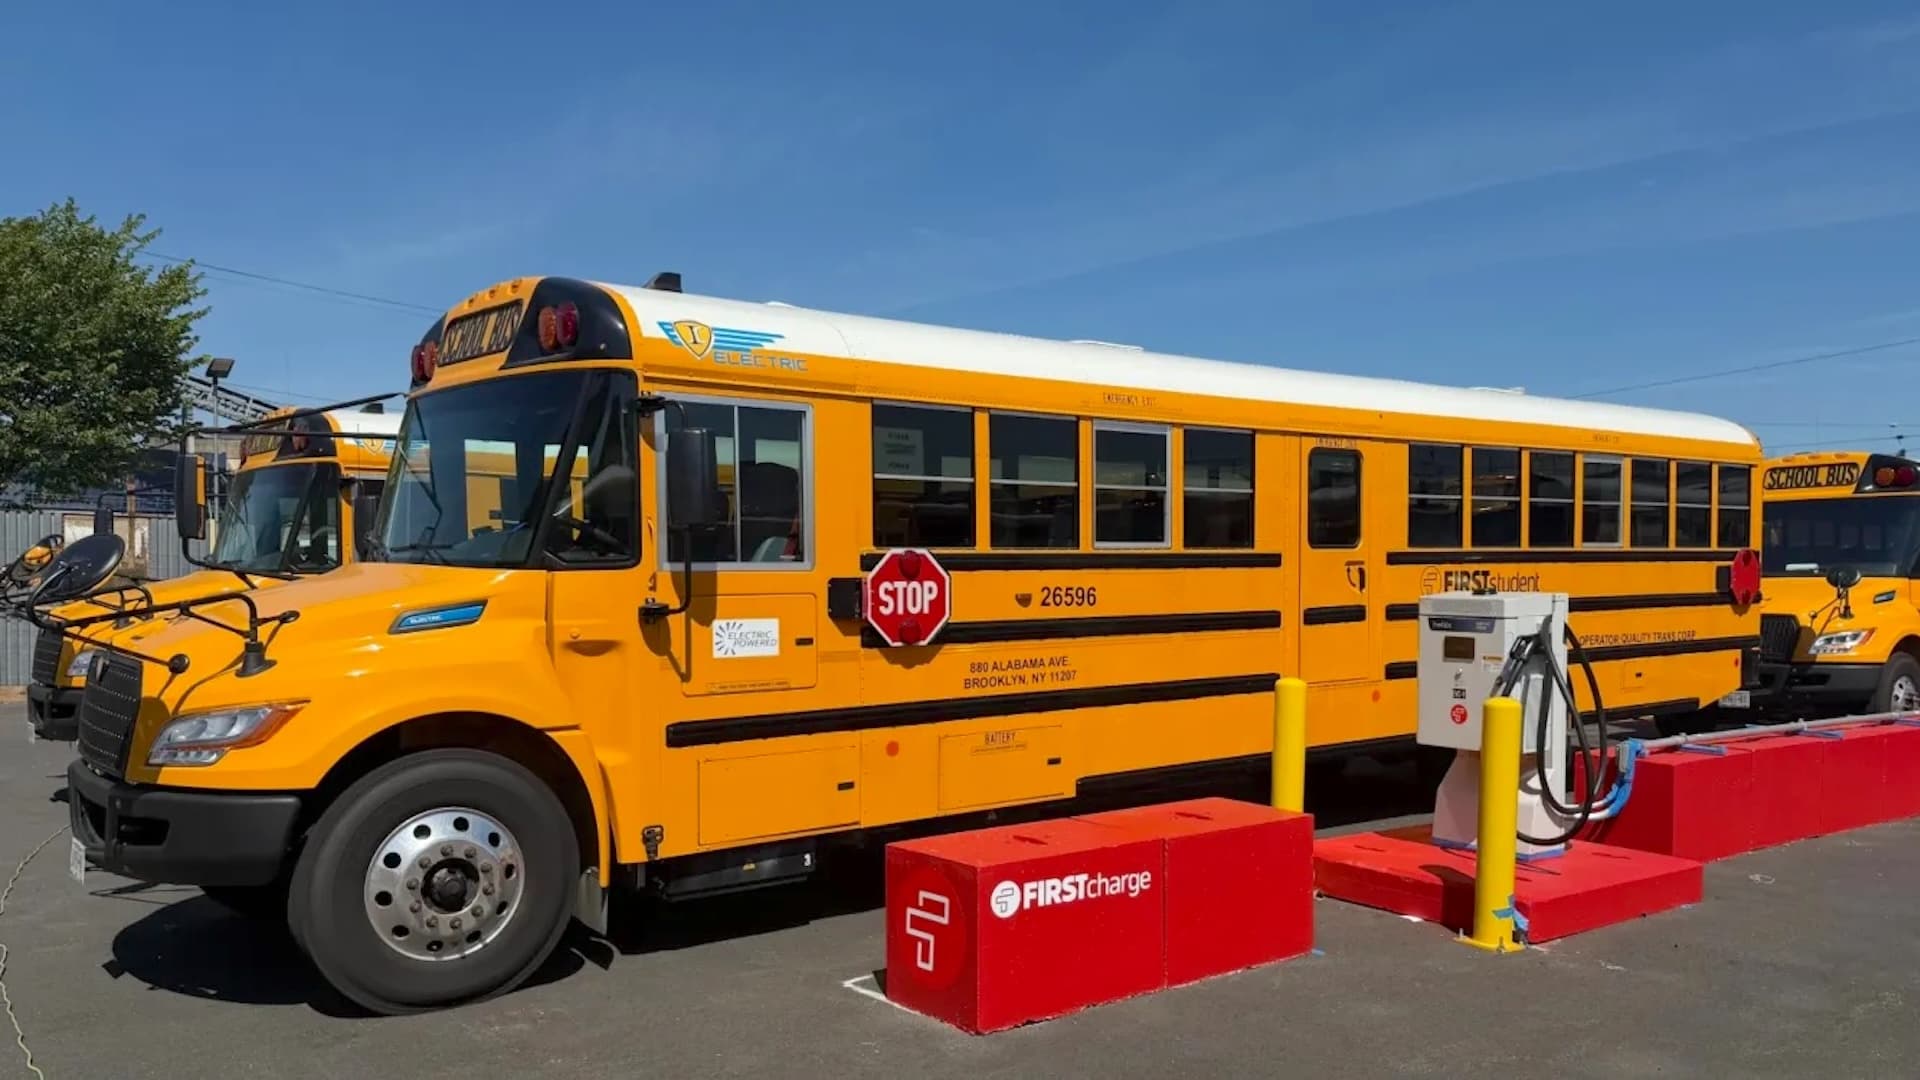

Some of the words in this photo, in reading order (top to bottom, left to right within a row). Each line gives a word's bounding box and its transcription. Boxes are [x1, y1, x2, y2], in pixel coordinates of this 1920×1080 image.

[440, 311, 489, 363] SCHOOL
[488, 302, 522, 354] BUS
[713, 351, 808, 372] ELECTRIC
[1767, 467, 1822, 488] SCHOOL
[1826, 463, 1856, 486] BUS
[879, 580, 938, 616] STOP
[1040, 586, 1097, 607] 26596
[728, 630, 772, 640] ELECTRIC
[733, 638, 778, 648] POWERED
[1580, 633, 1620, 646] OPERATOR
[1621, 631, 1651, 644] QUALITY
[1653, 630, 1676, 642] TRANS
[970, 662, 989, 673] 880
[991, 658, 1046, 671] ALABAMA
[964, 674, 1029, 689] BROOKLYN,
[1032, 672, 1047, 684] NY
[1050, 670, 1077, 682] 11207
[985, 731, 1017, 745] BATTERY
[1022, 871, 1152, 910] FIRSTcharge
